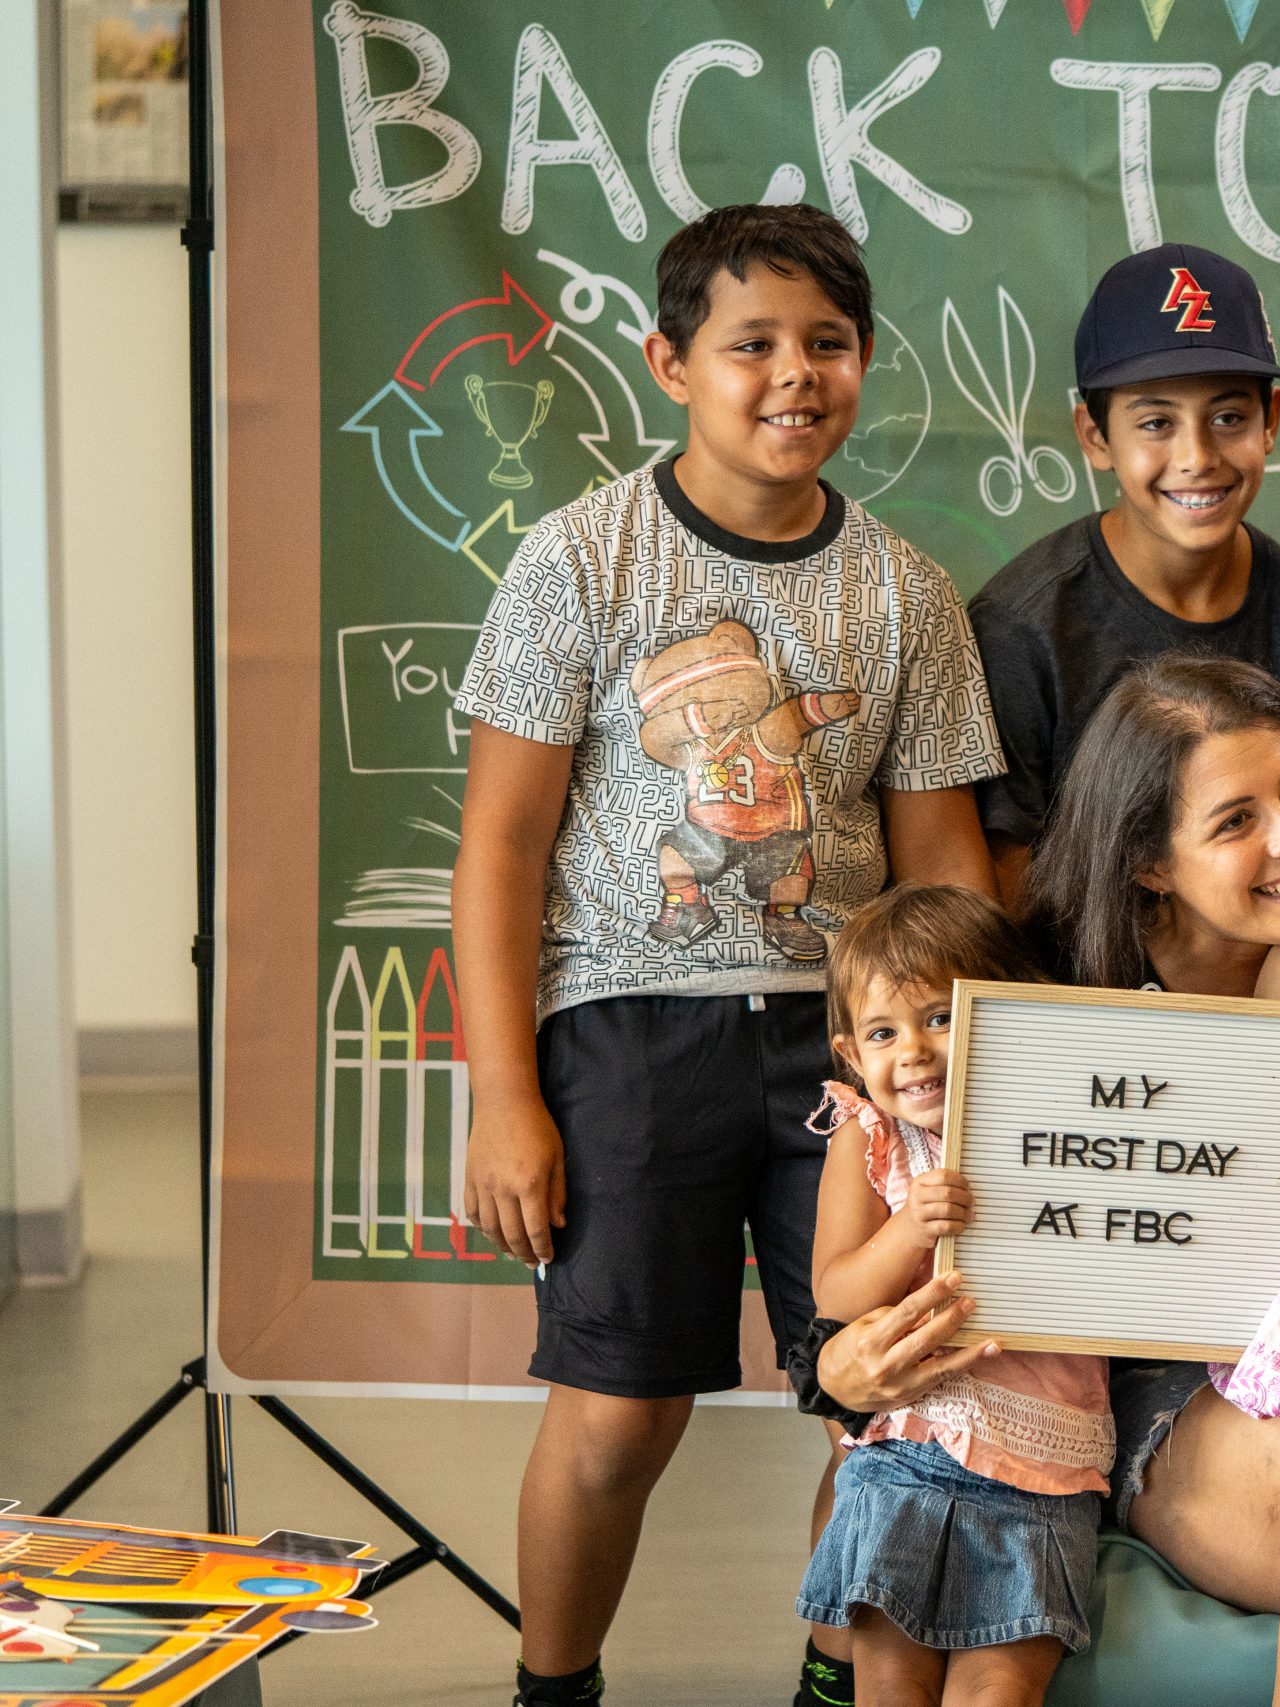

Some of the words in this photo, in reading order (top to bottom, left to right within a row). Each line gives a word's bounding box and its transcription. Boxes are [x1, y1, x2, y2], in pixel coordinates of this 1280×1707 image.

[323, 0, 973, 244] BACK
[1160, 268, 1216, 333] AZ
[639, 559, 678, 598] 23
[684, 560, 817, 608] LEGEND
[820, 577, 862, 615] 23
[504, 599, 549, 644] 23
[771, 603, 818, 641] 23
[775, 640, 897, 697] LEGEND
[460, 659, 572, 725] EGEND
[939, 719, 985, 765] 23
[636, 784, 681, 822] 23
[1091, 1074, 1168, 1109] MY
[1022, 1132, 1145, 1171] FIRST
[1155, 1140, 1239, 1178] DAY
[1030, 1201, 1079, 1239] AT
[1105, 1208, 1194, 1246] FBC
